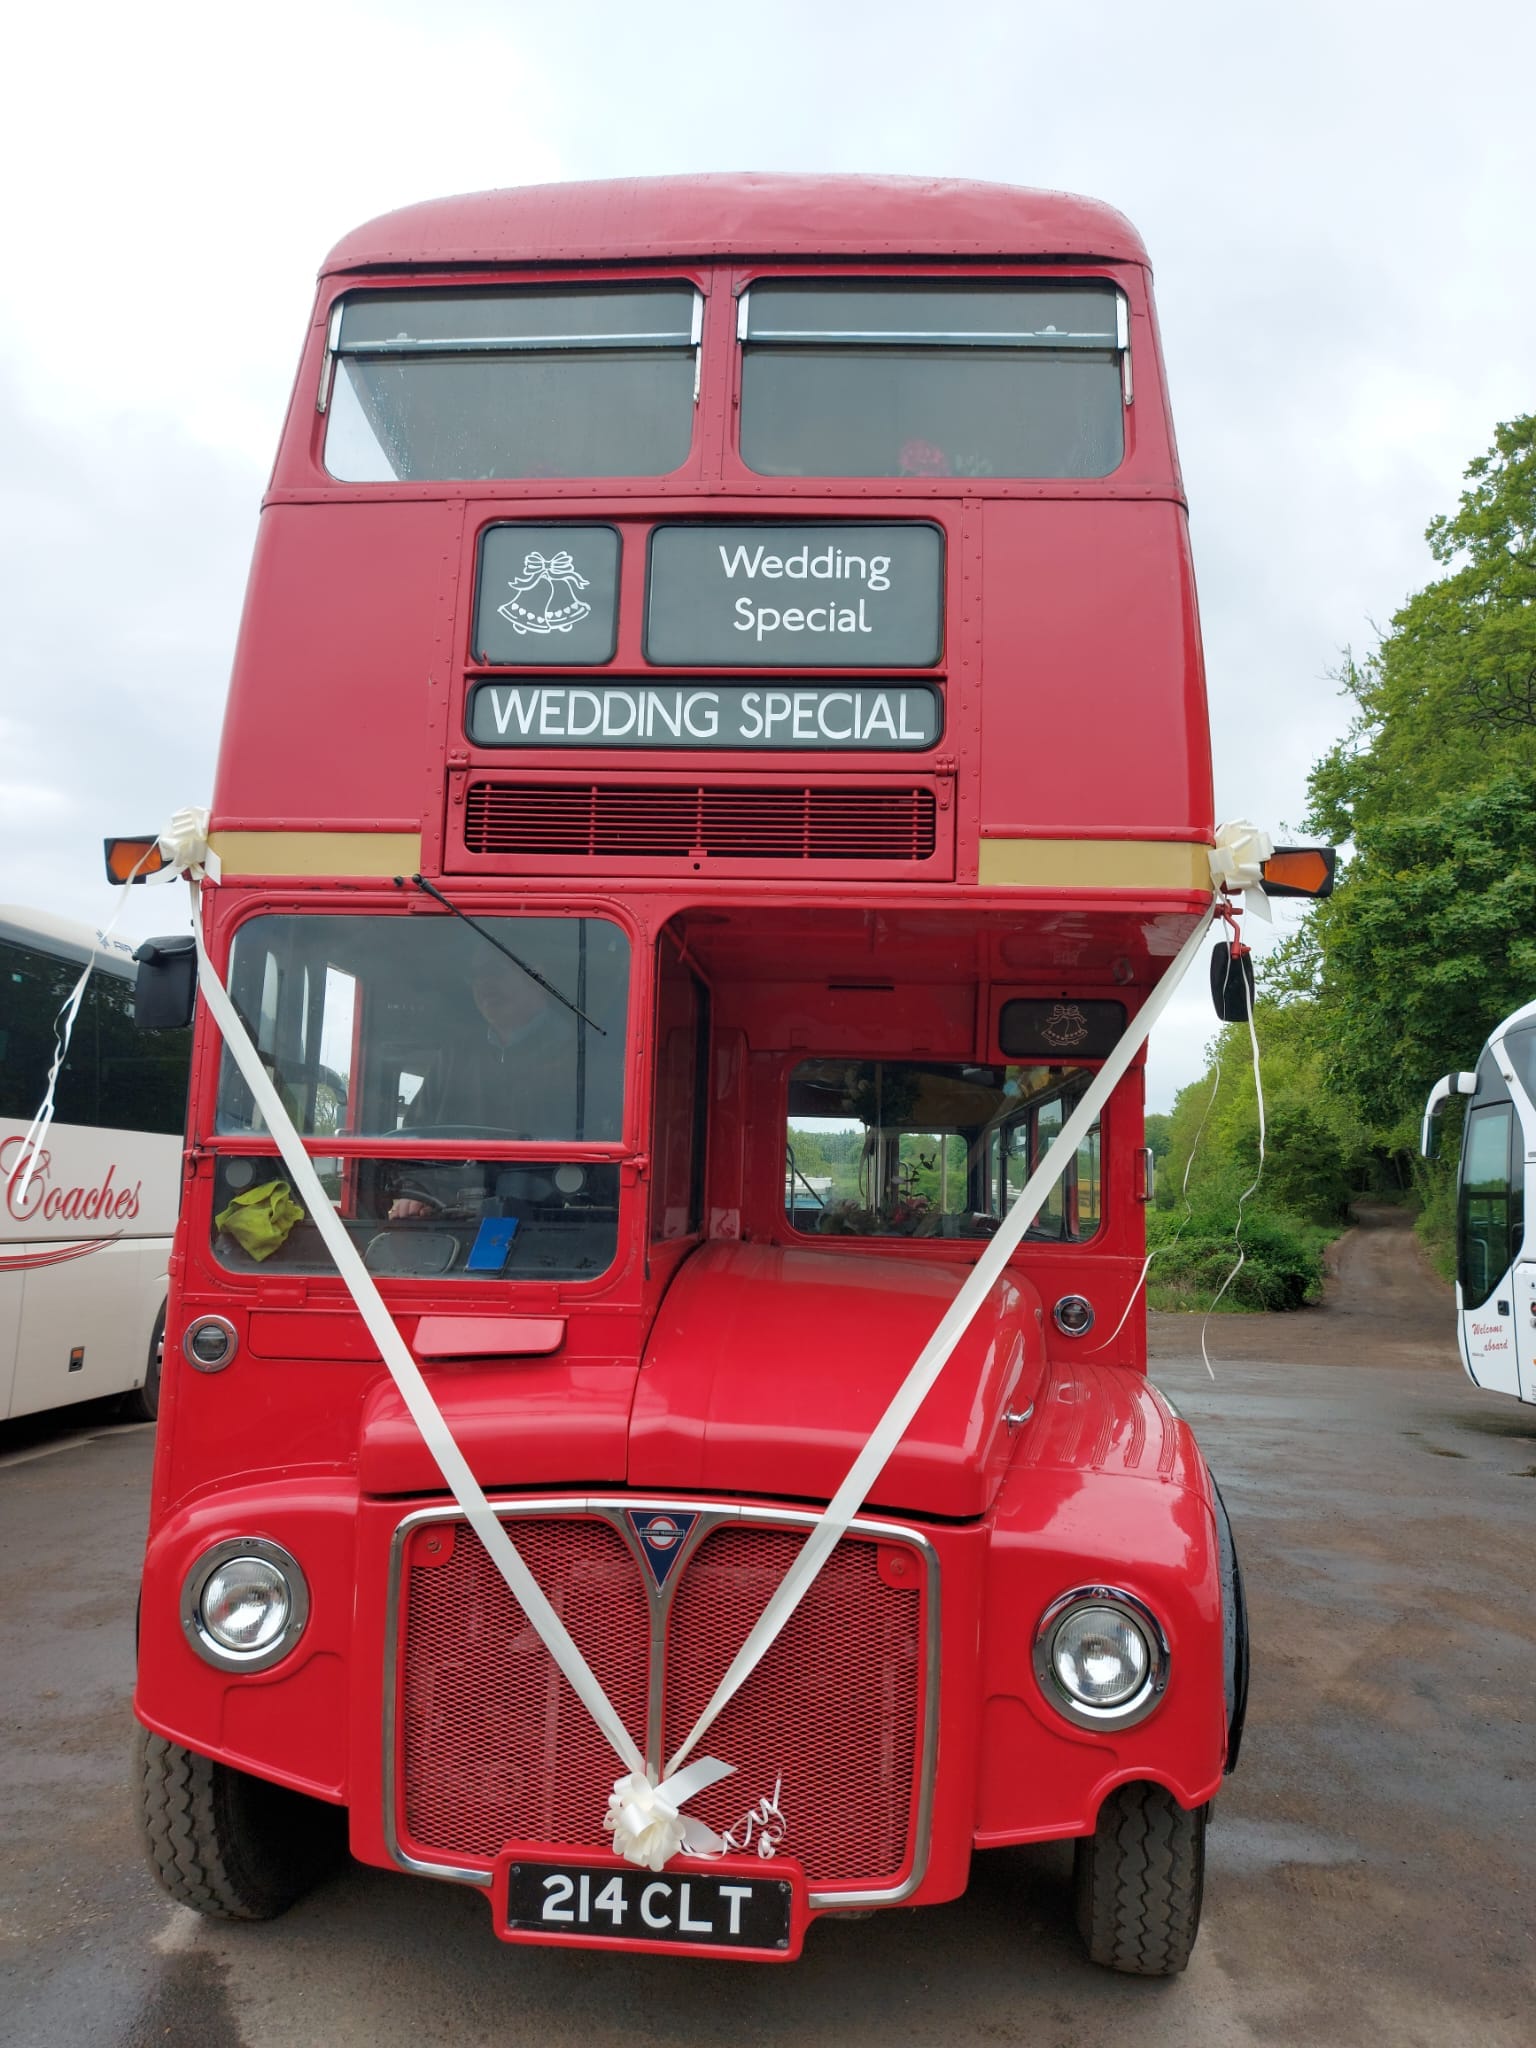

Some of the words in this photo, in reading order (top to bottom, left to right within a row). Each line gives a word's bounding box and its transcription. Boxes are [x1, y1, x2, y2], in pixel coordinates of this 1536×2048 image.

[719, 545, 891, 591] Wedding
[734, 597, 872, 641] Special
[490, 689, 719, 738] WEDDING
[739, 692, 925, 740] SPECIAL
[0, 1136, 142, 1222] Coaches
[1472, 1323, 1503, 1335] Welcome
[1484, 1338, 1508, 1351] aboard
[542, 1873, 628, 1925] 214
[640, 1881, 753, 1935] CLT
